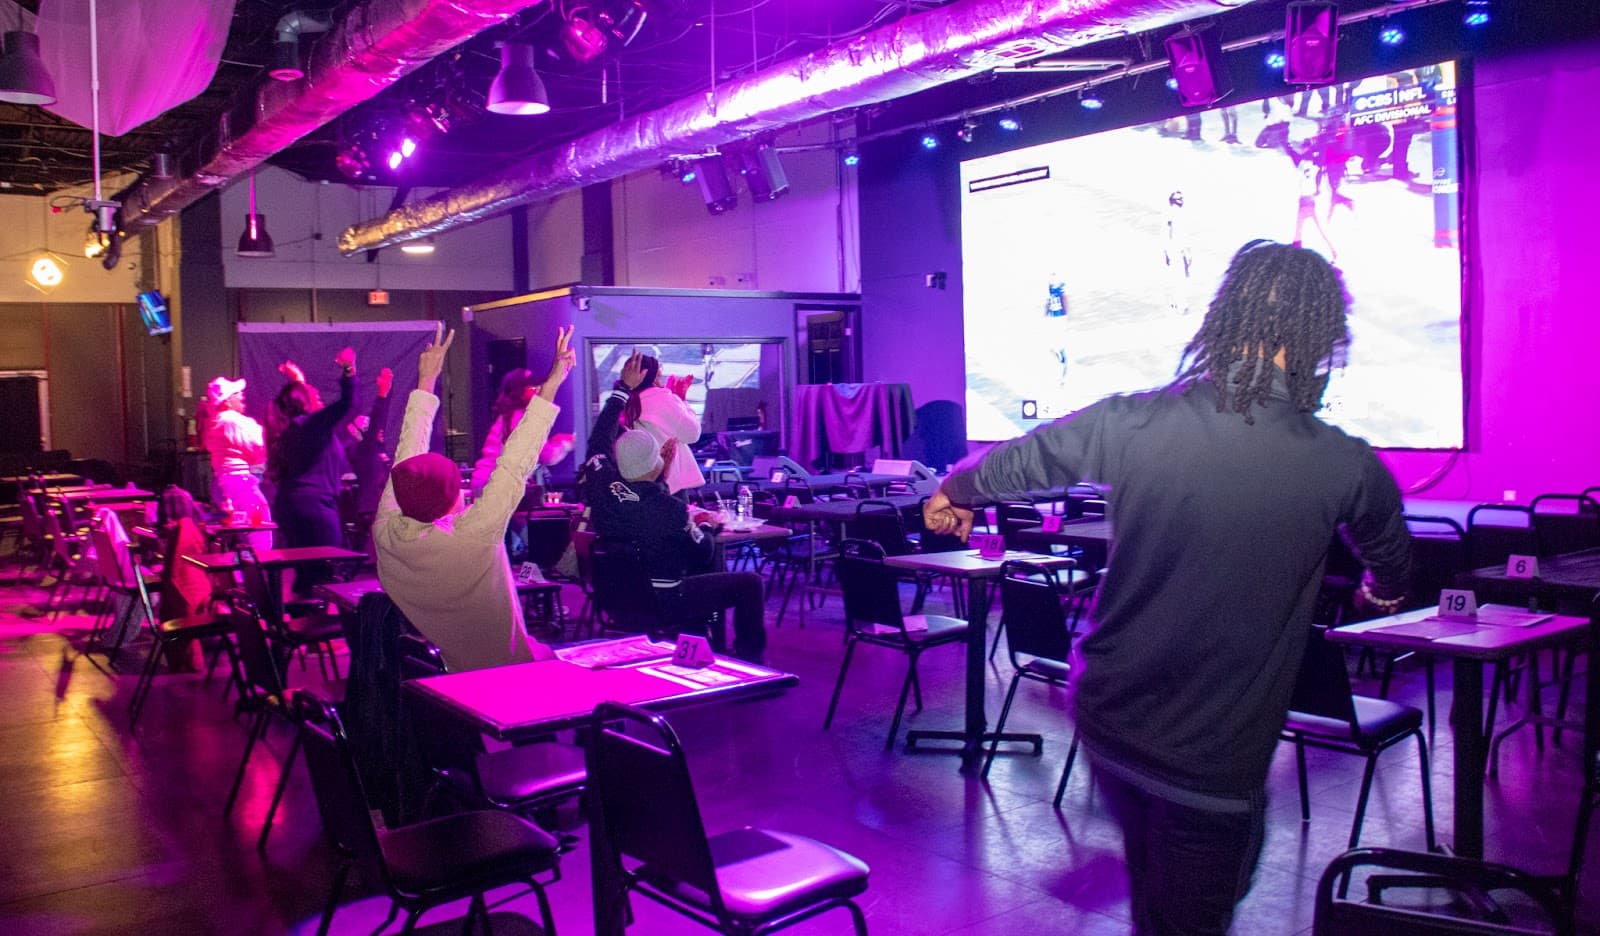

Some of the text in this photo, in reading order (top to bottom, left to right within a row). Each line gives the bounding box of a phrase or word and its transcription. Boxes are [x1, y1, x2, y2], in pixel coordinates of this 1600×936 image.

[1367, 92, 1393, 108] CBS
[1398, 87, 1427, 103] NFL
[1353, 104, 1432, 126] AFC DIVISIONAL
[983, 537, 999, 551] 18
[1515, 559, 1527, 574] 6
[1446, 594, 1466, 612] 19
[677, 640, 698, 661] 31
